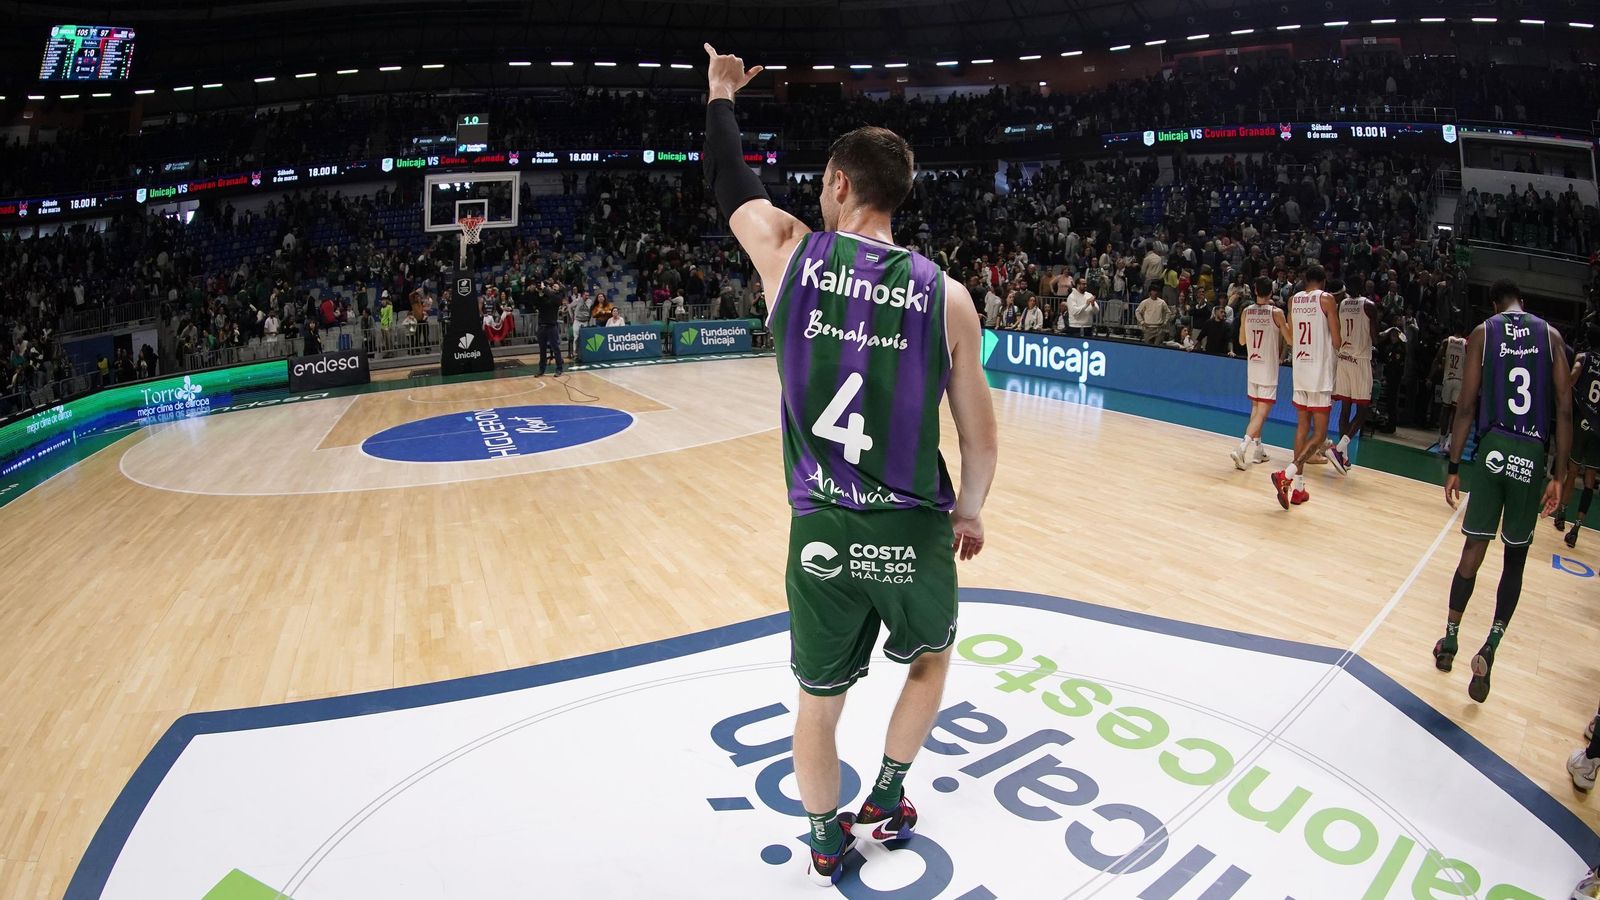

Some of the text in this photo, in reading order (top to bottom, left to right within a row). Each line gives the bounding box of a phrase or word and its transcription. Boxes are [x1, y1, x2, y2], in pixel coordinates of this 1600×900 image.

[463, 116, 480, 125] 1.0
[1311, 123, 1333, 131] Sábado
[1158, 126, 1276, 143] Unicaja VS Coviran Granada
[1312, 131, 1320, 139] de
[1350, 126, 1378, 137] 18.00
[1379, 126, 1387, 138] H
[396, 158, 426, 168] Unicaja
[427, 156, 439, 166] VS
[569, 153, 592, 162] 18.00
[592, 153, 599, 161] H
[657, 152, 687, 162] Unicaja
[687, 152, 700, 161] VS
[308, 167, 330, 177] 18.00
[331, 165, 338, 175] H
[149, 186, 177, 198] Unicaja
[177, 184, 188, 194] VS
[801, 258, 931, 313] Kalinoski
[701, 327, 746, 338] Fundación
[1299, 321, 1312, 345] 21
[1346, 318, 1354, 337] 11
[1505, 323, 1530, 340] Ejim
[607, 331, 656, 344] Fundación
[702, 335, 735, 346] Unicaja
[1252, 329, 1264, 349] 17
[608, 341, 645, 353] Unicaja
[454, 350, 481, 360] Unicaja
[1007, 335, 1106, 383] Unicaja
[293, 356, 359, 376] endesa
[1508, 367, 1532, 415] 3
[1589, 380, 1600, 403] 6
[137, 406, 155, 418] mejor
[156, 403, 173, 414] clima
[174, 401, 184, 410] de
[811, 372, 873, 465] 4
[1508, 454, 1534, 470] COSTA
[1507, 463, 1532, 477] DEL SOL
[849, 543, 917, 560] COSTA
[850, 560, 916, 573] DEL SOL
[851, 571, 914, 584] MÁLAGA
